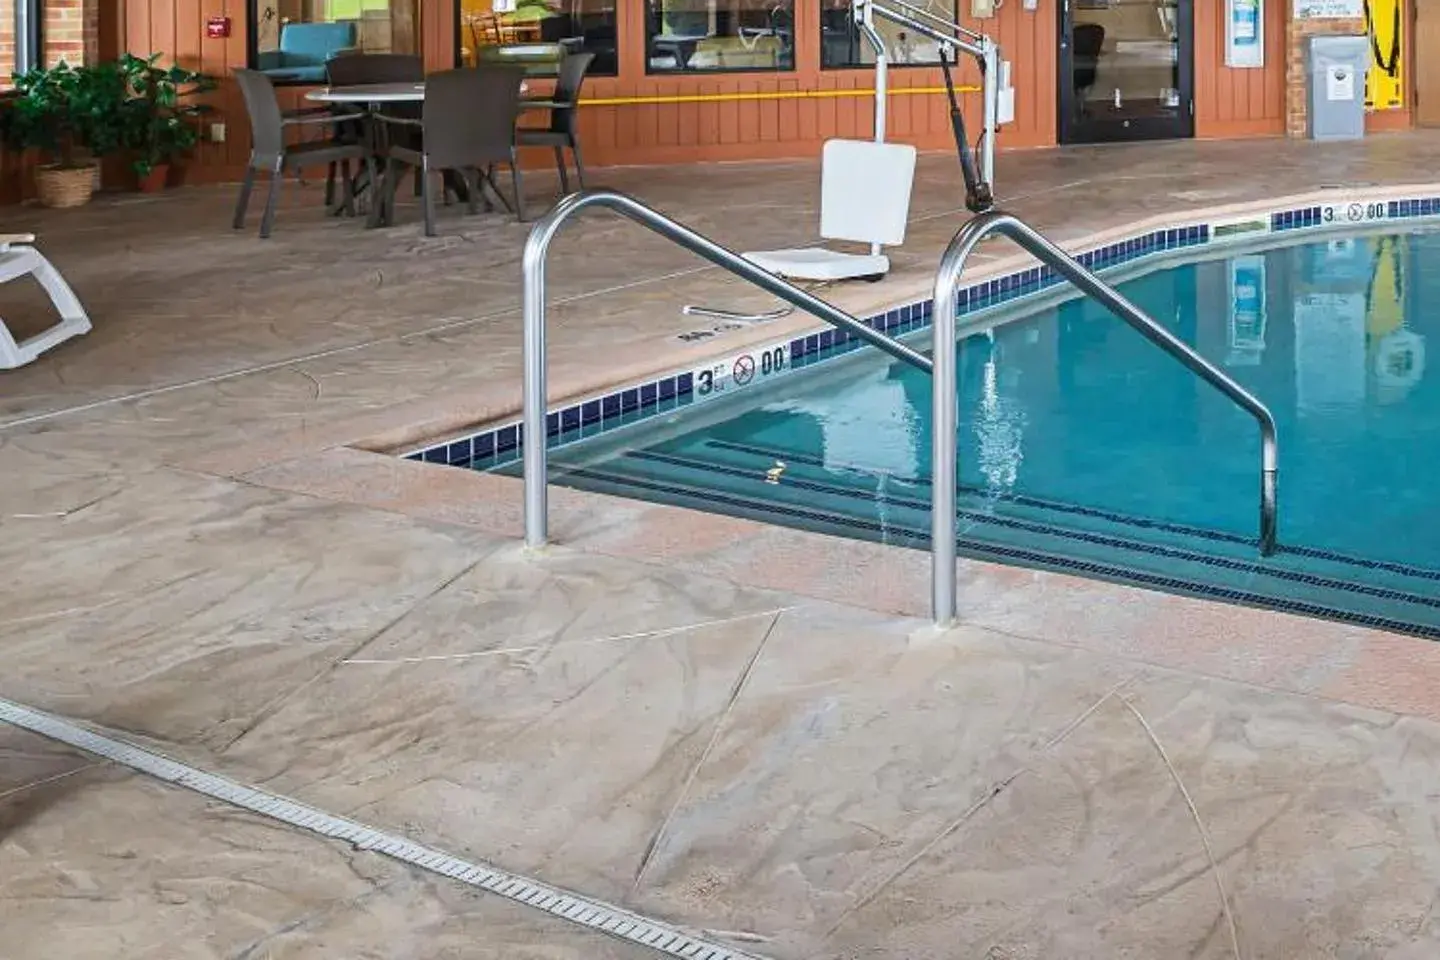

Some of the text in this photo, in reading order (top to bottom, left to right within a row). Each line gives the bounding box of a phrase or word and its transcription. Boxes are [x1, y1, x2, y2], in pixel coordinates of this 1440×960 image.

[1324, 207, 1333, 221] 3
[698, 369, 713, 396] 3
[761, 347, 784, 376] 00
